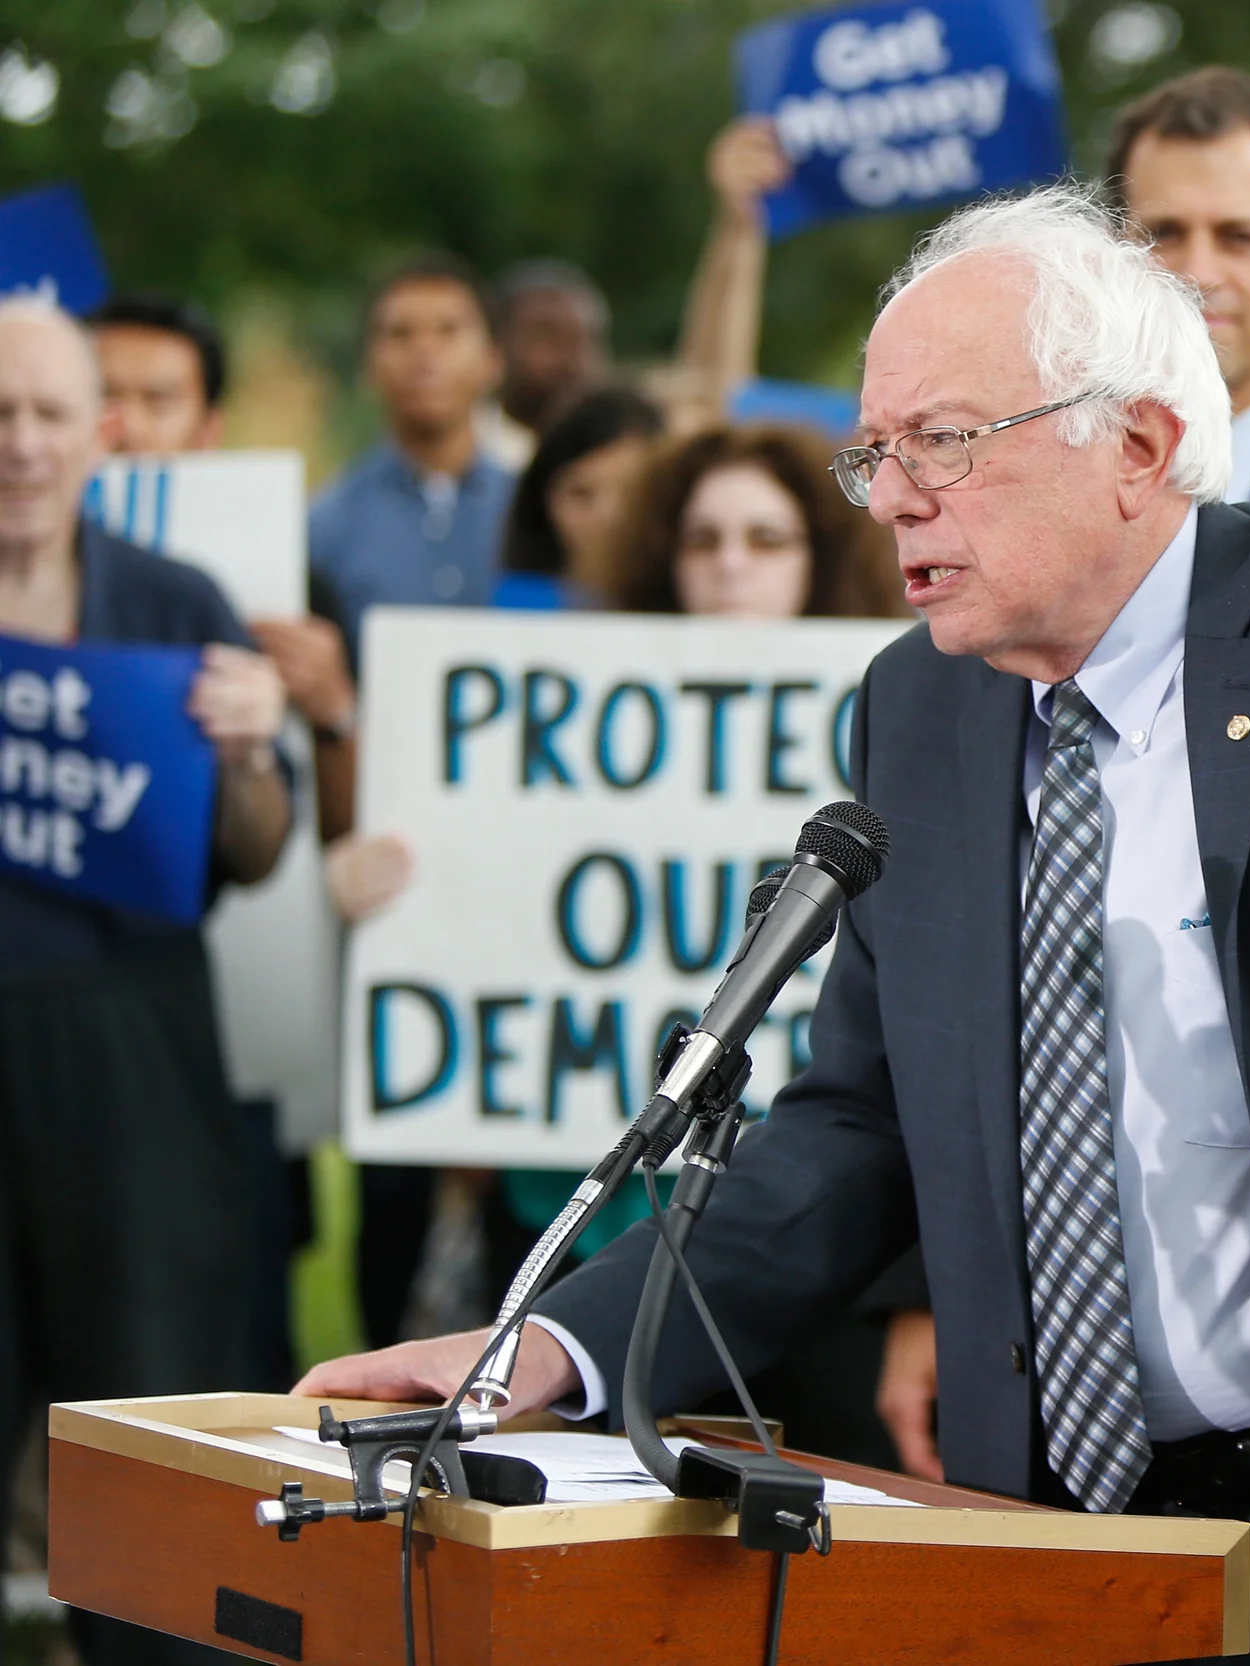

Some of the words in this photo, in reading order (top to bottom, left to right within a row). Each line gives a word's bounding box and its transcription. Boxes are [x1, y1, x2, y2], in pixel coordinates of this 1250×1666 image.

[813, 8, 949, 91] Get
[776, 65, 1008, 163] Money
[838, 134, 981, 207] Out
[0, 665, 91, 740] et
[556, 848, 816, 976] OU
